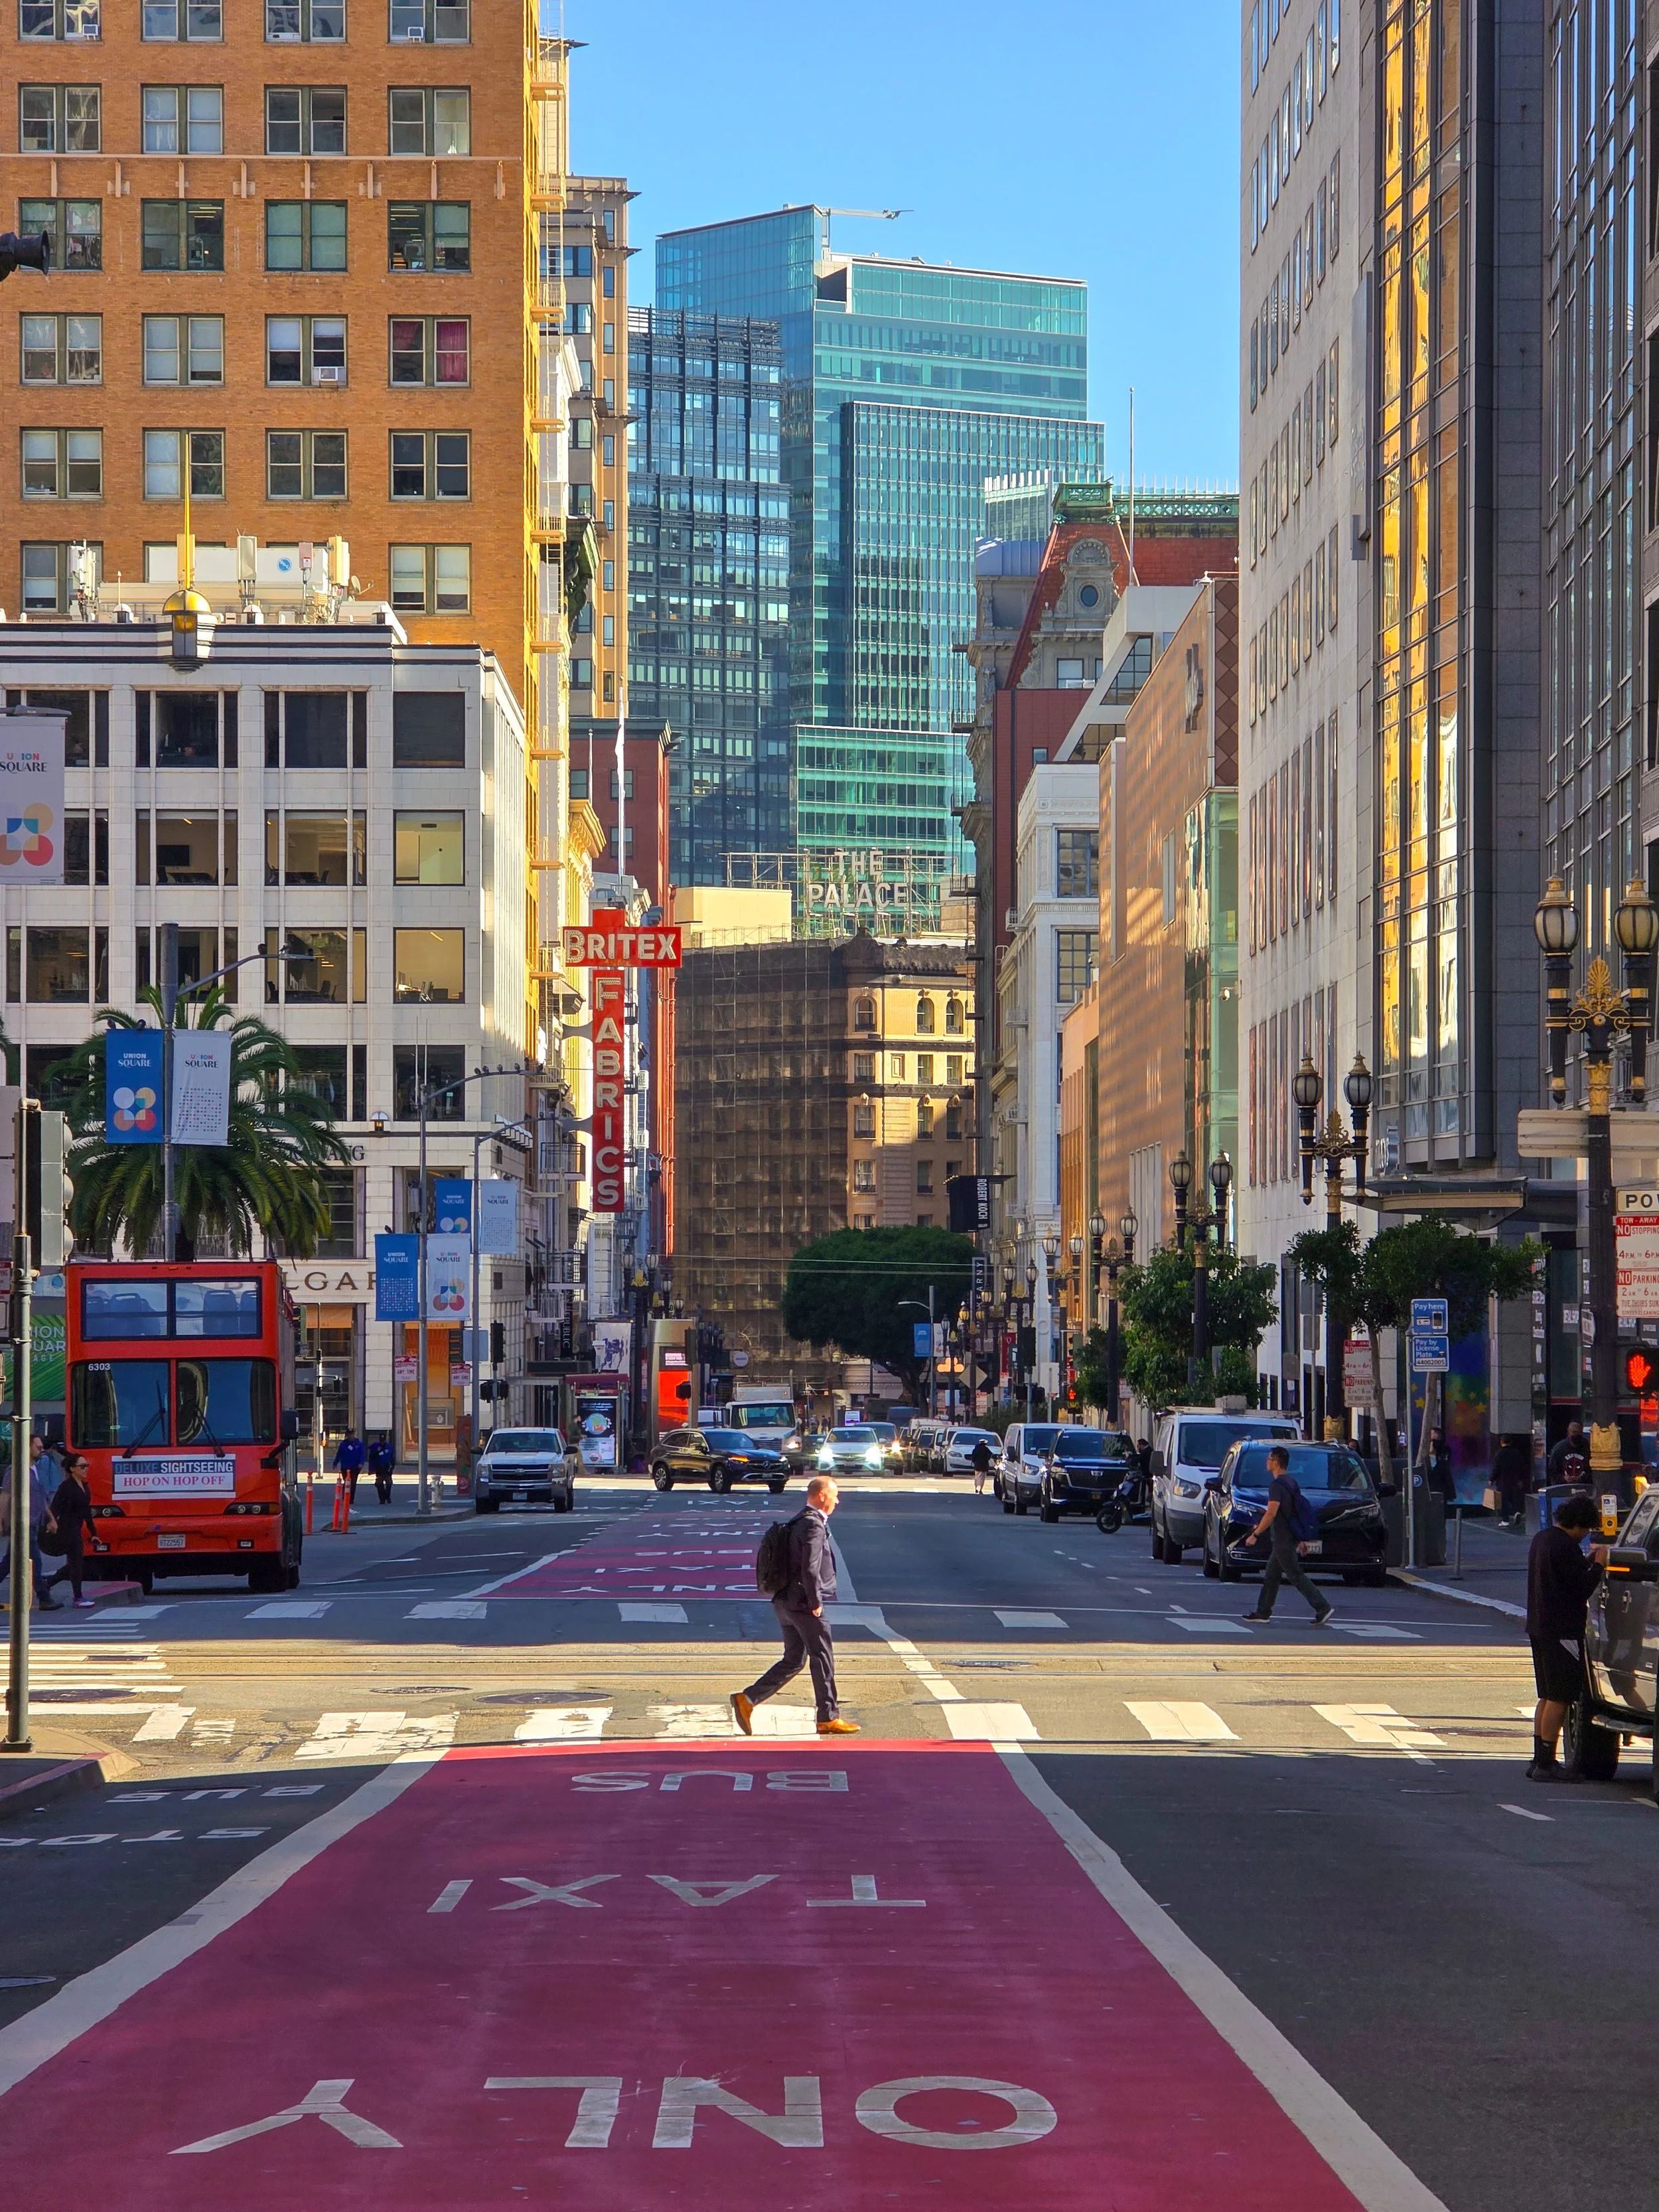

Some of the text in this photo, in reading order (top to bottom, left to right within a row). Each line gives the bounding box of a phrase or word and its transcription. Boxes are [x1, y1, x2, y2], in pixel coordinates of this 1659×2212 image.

[0, 761, 48, 774] SQUARE
[834, 850, 883, 876] THE
[808, 882, 908, 908] PALACE
[565, 929, 676, 964] BRITEX
[117, 1059, 151, 1068] SQUARE
[184, 1060, 219, 1069] SQUARE
[595, 977, 622, 1205] FABRICS
[977, 1179, 988, 1219] ROBERT KOCH
[1625, 1194, 1659, 1209] PO
[1617, 1224, 1630, 1235] NO
[1619, 1272, 1631, 1284] NO
[88, 1363, 110, 1371] 6303
[1345, 1377, 1354, 1386] NO
[115, 1461, 233, 1474] DELUXE SIGHTSEEING
[123, 1475, 226, 1487] HOP ON HOP OFF
[595, 1564, 757, 1574] TAXI
[559, 1584, 758, 1593] ONLY
[571, 1769, 849, 1792] BUS
[105, 1785, 325, 1803] BUS
[427, 1874, 926, 1913] TAXI
[167, 2075, 1058, 2154] ONLY
